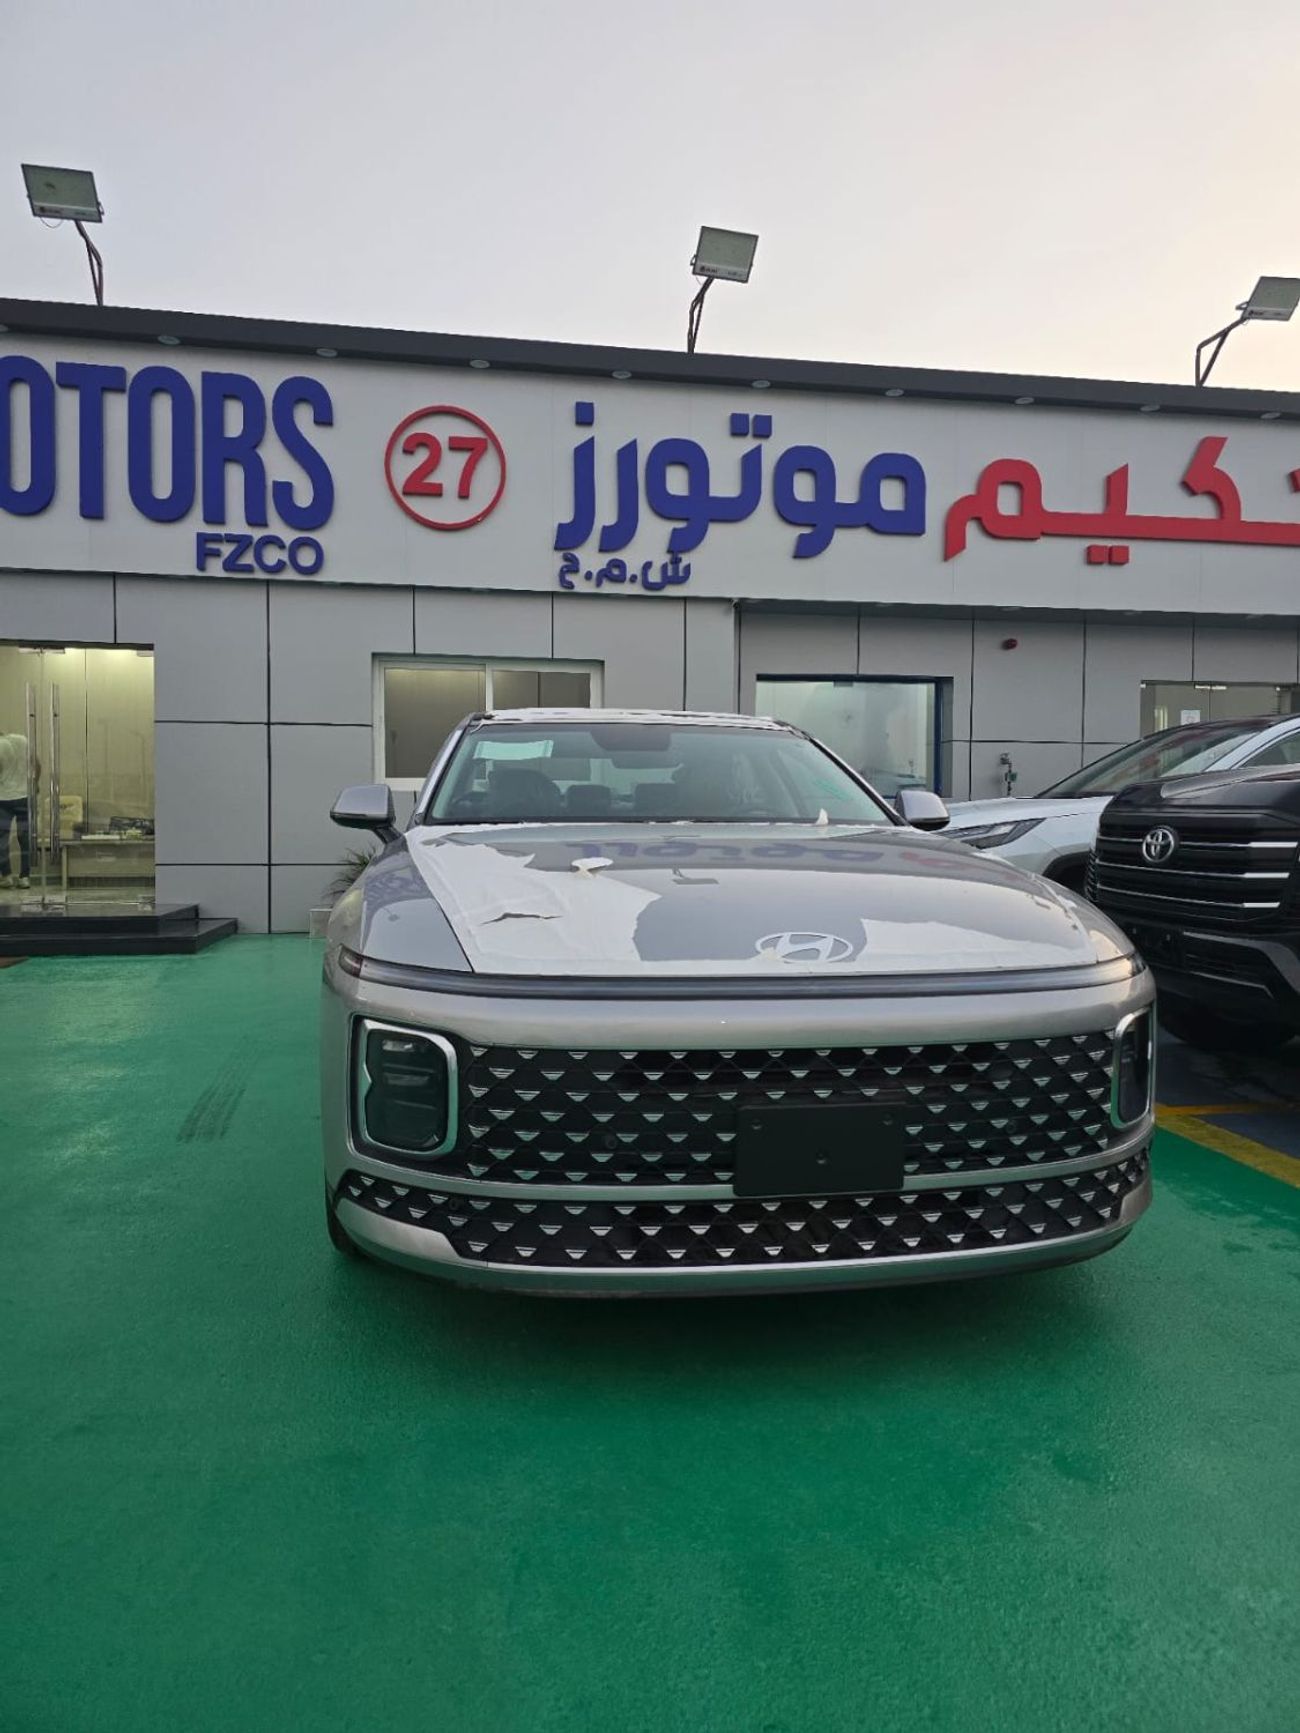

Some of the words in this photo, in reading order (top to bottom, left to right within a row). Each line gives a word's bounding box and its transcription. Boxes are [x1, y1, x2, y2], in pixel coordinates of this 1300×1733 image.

[0, 355, 335, 530] OTORS
[402, 433, 488, 499] 27
[554, 402, 926, 558] موتورز
[944, 436, 1300, 564] كيم
[196, 532, 325, 574] FZCO
